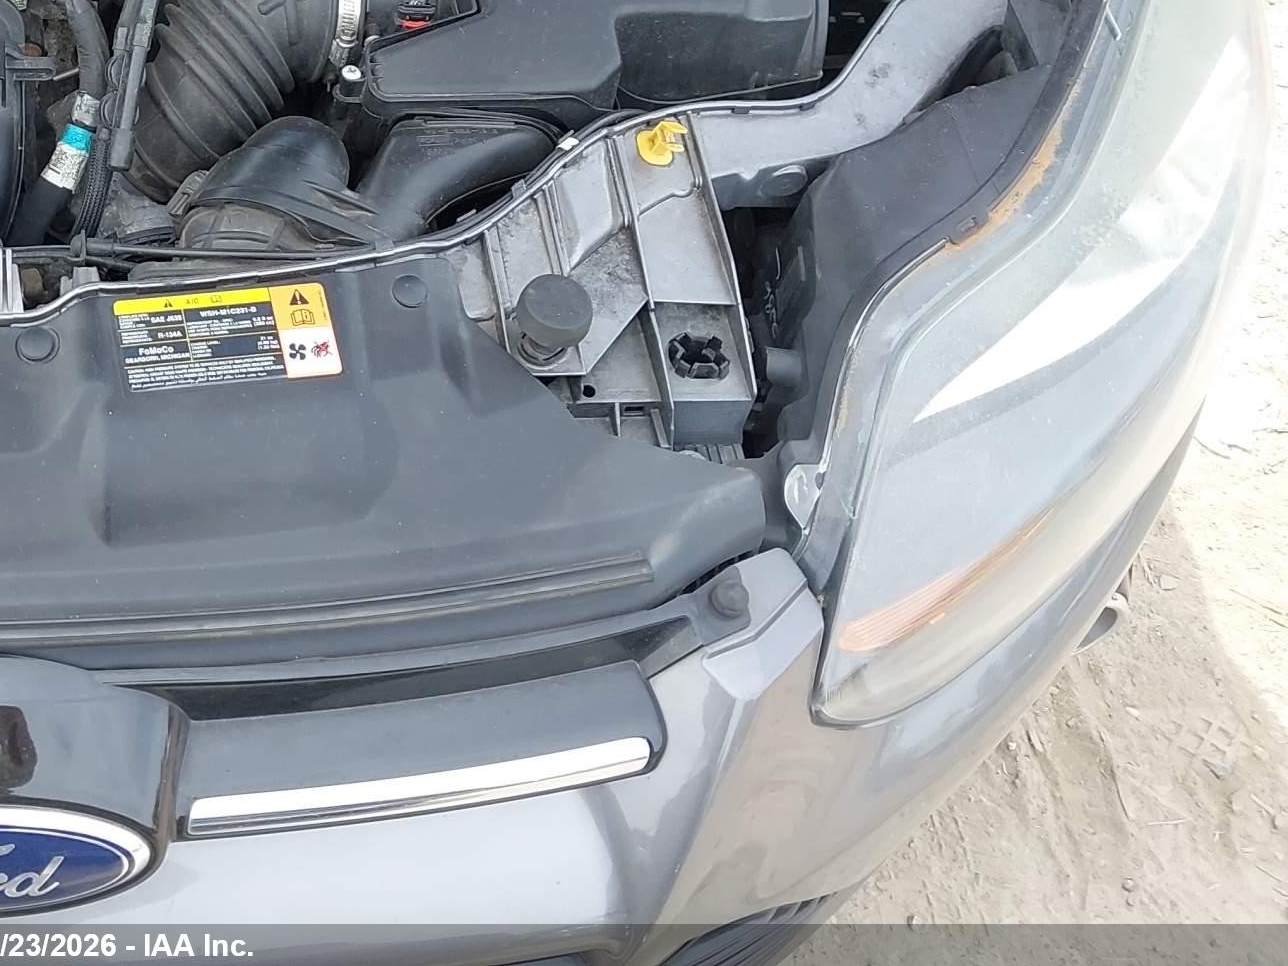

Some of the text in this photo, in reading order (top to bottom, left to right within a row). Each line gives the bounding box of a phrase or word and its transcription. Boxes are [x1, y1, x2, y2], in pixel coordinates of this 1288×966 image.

[157, 330, 183, 339] R-134A
[138, 345, 175, 356] FoMoCo
[160, 352, 191, 360] MICHIGAN
